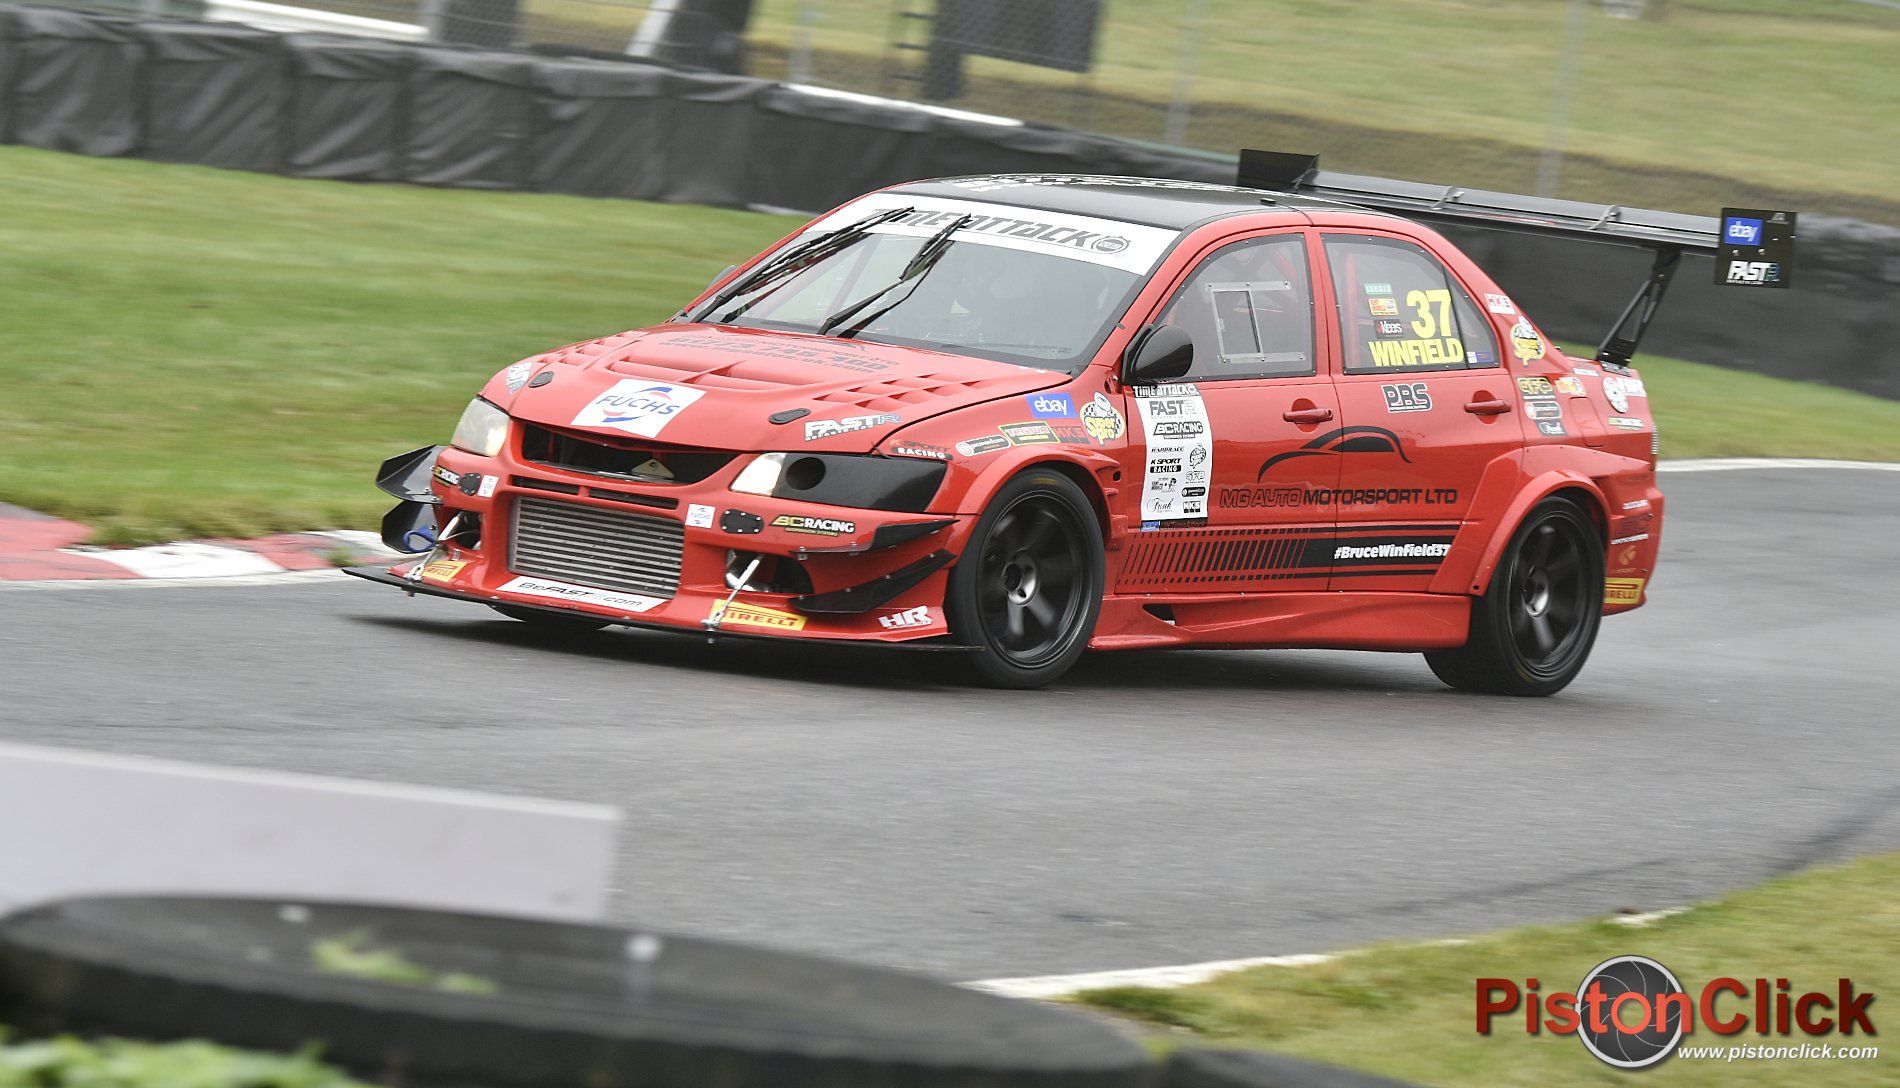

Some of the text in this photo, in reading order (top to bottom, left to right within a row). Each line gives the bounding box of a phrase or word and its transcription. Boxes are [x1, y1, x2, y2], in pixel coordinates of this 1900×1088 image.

[1729, 221, 1758, 241] ebay
[1407, 290, 1452, 338] 37
[1368, 337, 1464, 366] WINFIELD
[596, 395, 680, 416] FUCHS
[1035, 397, 1067, 415] ebay
[898, 447, 946, 459] RACING
[1153, 465, 1178, 473] RACING
[1220, 489, 1249, 508] MG
[1251, 488, 1303, 507] AUTO
[1304, 488, 1422, 506] MOTORSPORT
[1425, 489, 1457, 505] LTD
[804, 518, 855, 533] RACING
[1334, 544, 1452, 560] #BruceWinfield37
[726, 611, 796, 627] IRELLI
